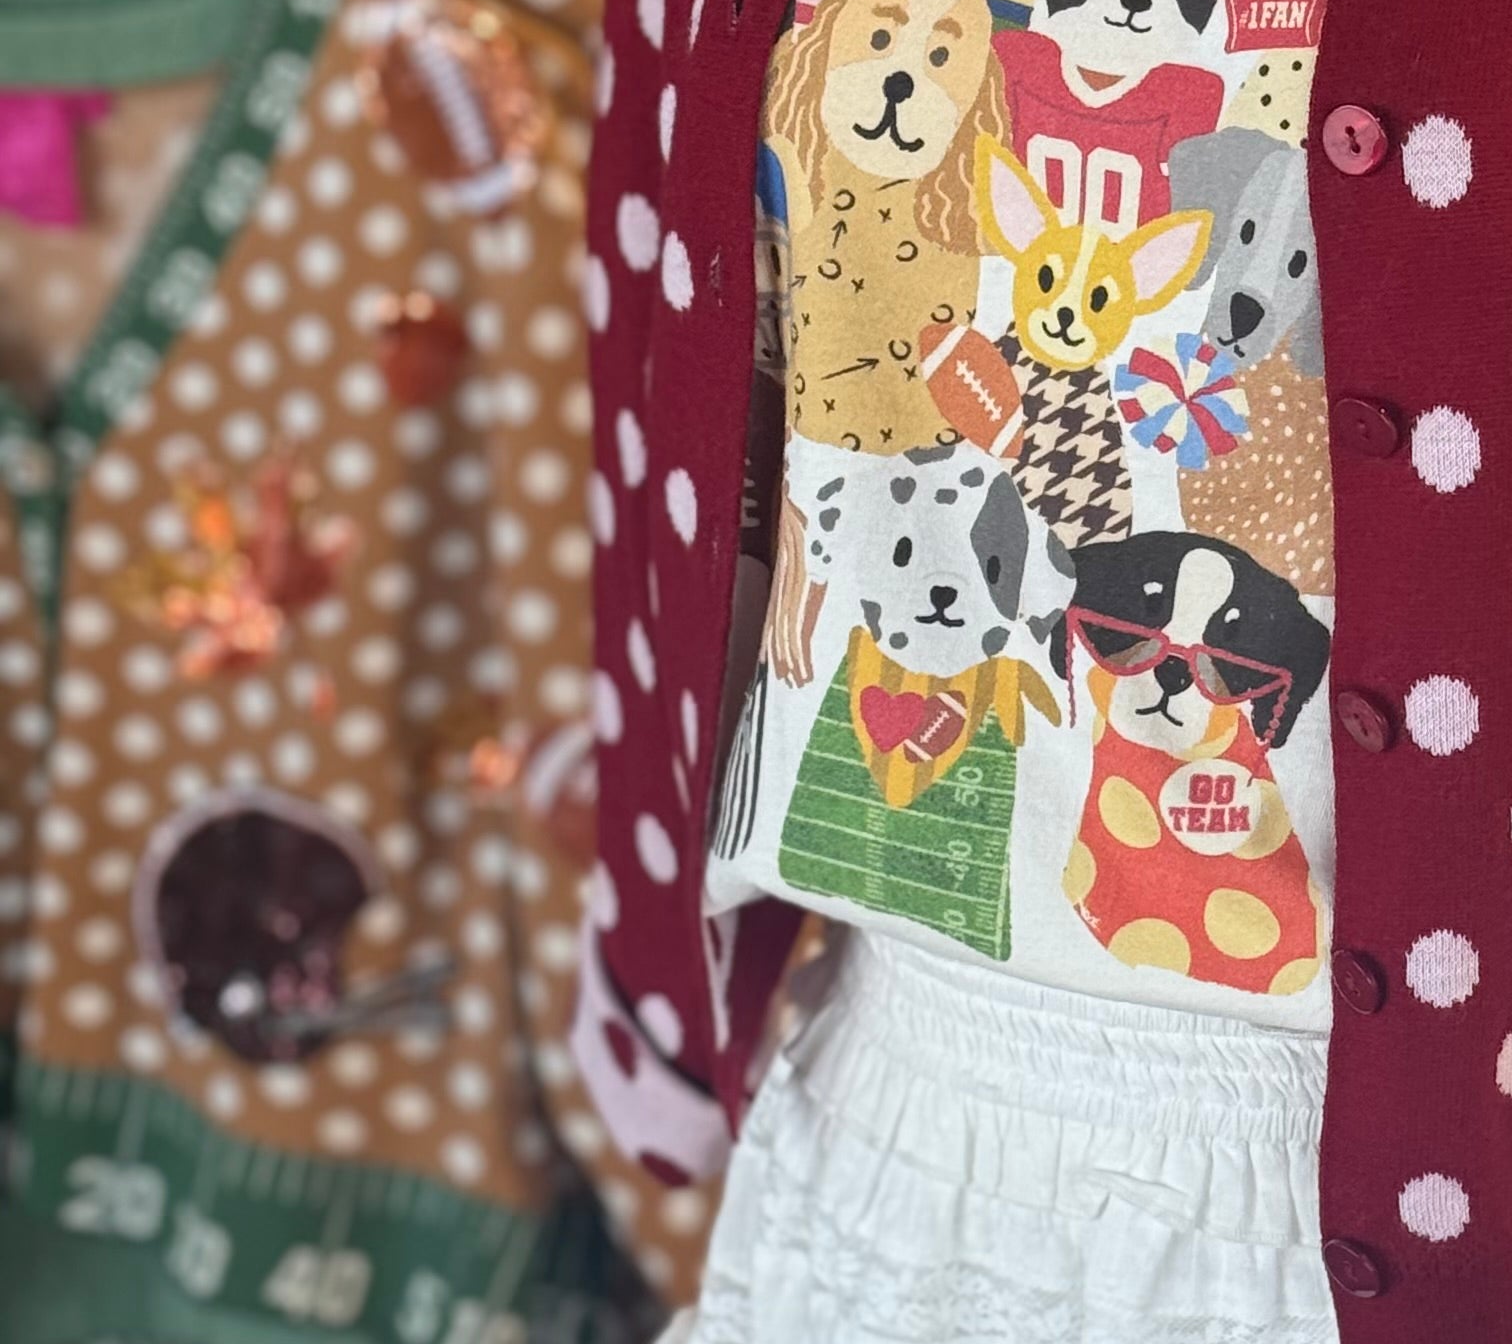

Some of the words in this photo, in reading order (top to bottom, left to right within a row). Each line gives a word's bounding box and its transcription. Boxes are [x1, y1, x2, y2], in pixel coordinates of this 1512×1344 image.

[1026, 133, 1143, 244] 00
[954, 765, 984, 808] 50
[1188, 773, 1236, 805] GO
[1167, 805, 1251, 833] TEAM
